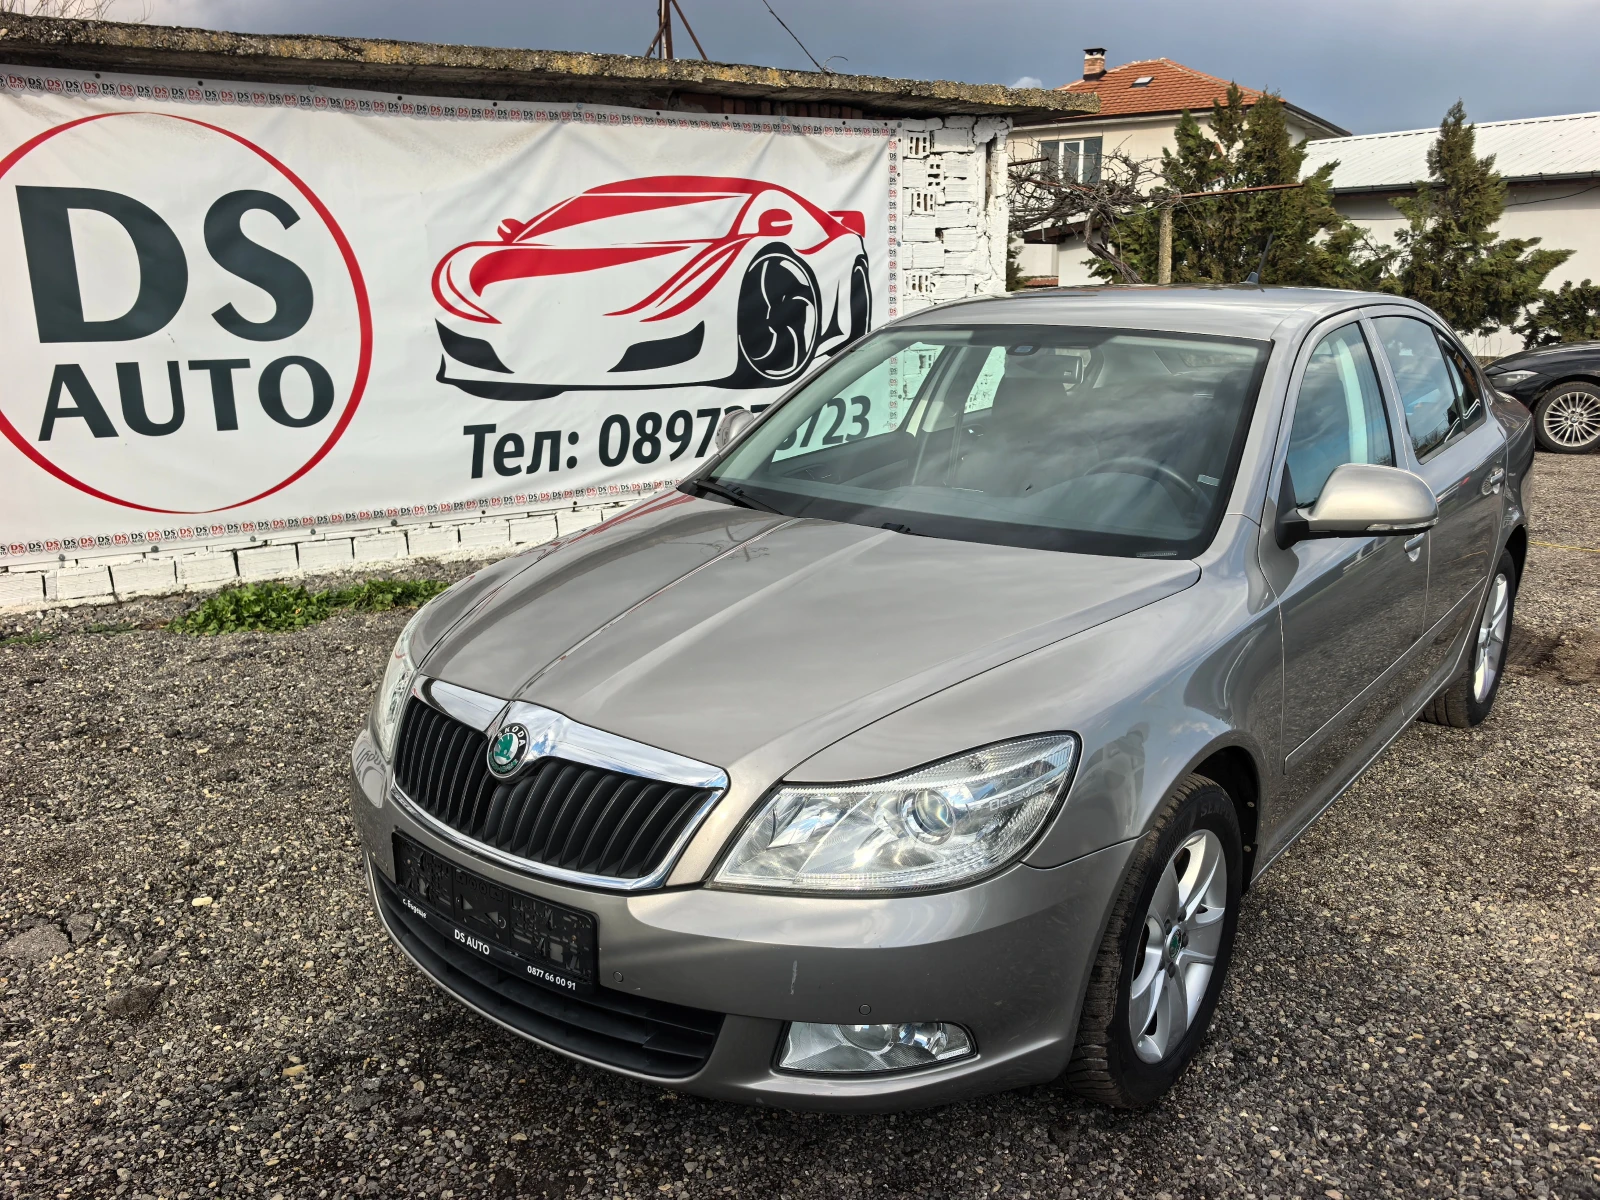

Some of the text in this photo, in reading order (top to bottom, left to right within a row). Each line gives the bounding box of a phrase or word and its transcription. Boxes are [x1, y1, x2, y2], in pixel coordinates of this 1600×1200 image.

[15, 185, 314, 343] DS
[38, 356, 334, 441] AUTO
[463, 424, 579, 478] Тел:
[455, 929, 489, 955] DS AUTO
[527, 966, 576, 990] 0877 66 00 91
